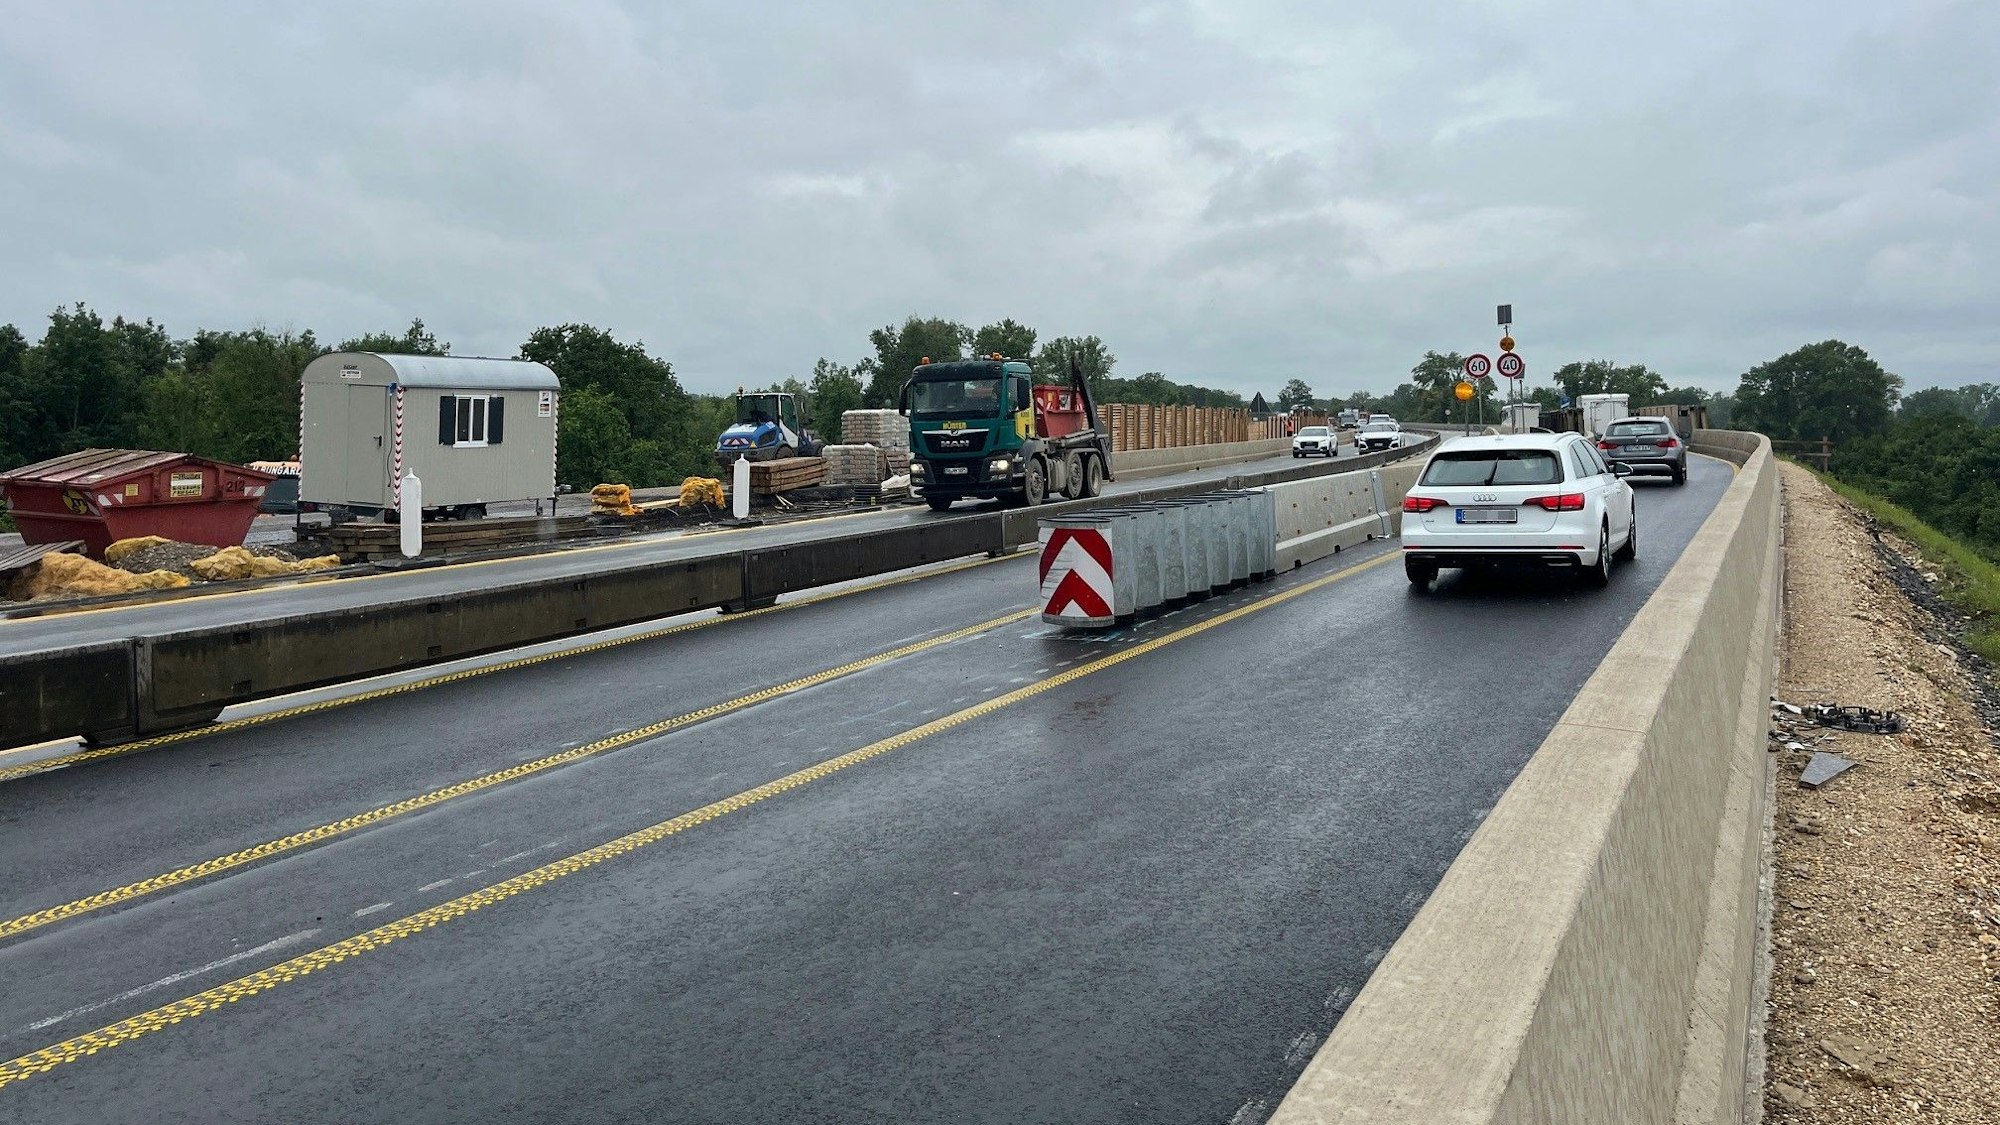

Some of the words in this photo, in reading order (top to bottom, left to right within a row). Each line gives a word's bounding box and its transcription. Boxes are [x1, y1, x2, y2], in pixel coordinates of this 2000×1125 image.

[1471, 360, 1485, 371] 60
[1503, 359, 1517, 370] 40
[941, 440, 970, 448] MAN
[226, 480, 245, 493] 212
